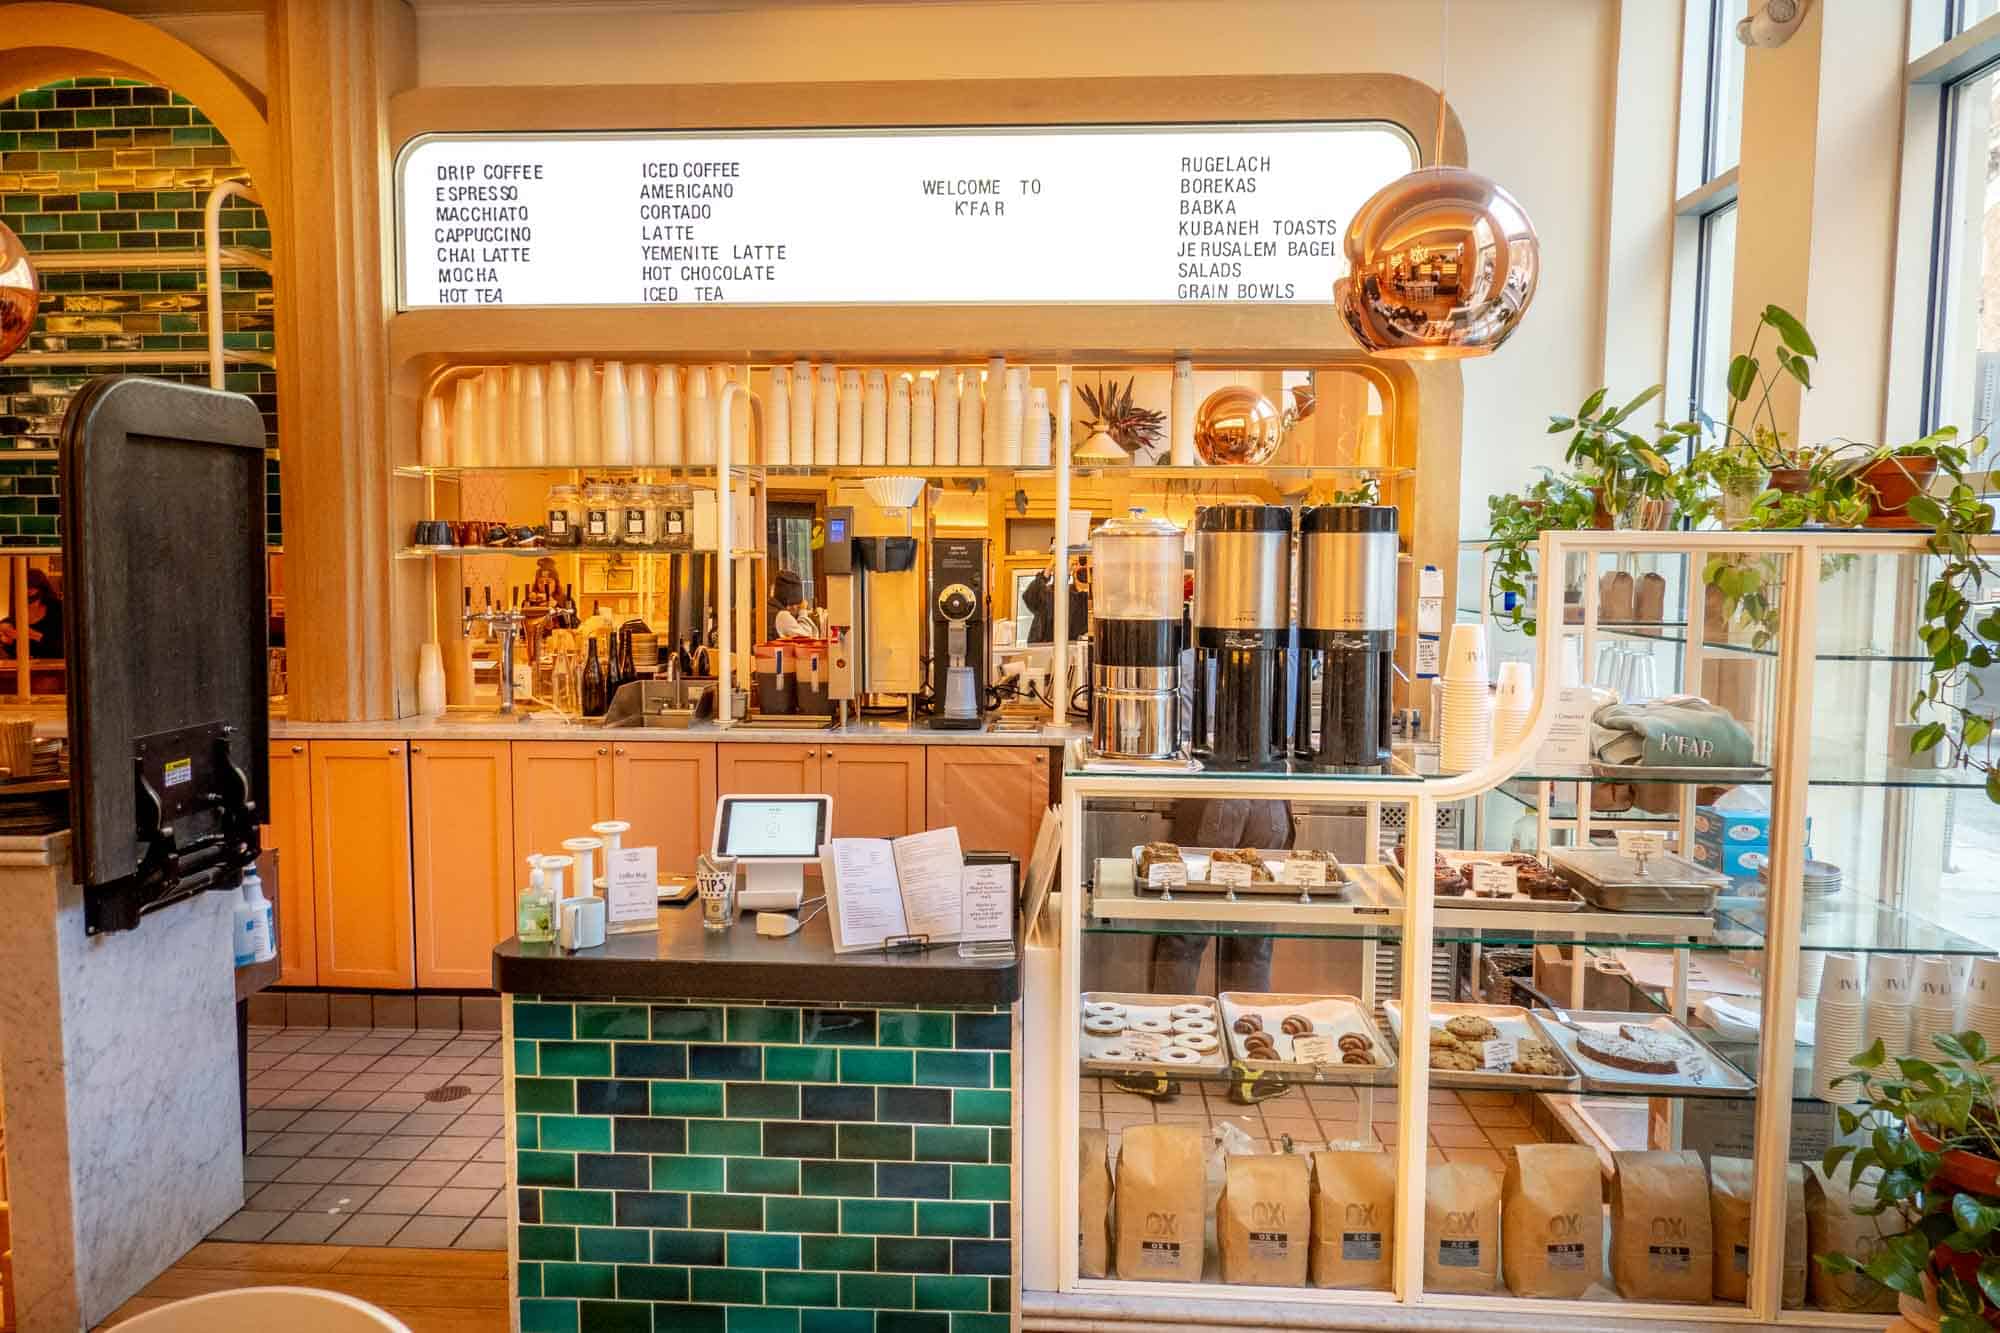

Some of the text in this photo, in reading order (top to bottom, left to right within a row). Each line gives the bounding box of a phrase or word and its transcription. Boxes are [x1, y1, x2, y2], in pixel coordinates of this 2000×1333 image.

[643, 162, 739, 178] ICED COFFEE
[1182, 156, 1270, 172] RUGELACH
[438, 165, 543, 180] DRIP COFFEE
[640, 183, 733, 199] AMERICANO
[923, 179, 1040, 195] WELCOME TO
[1181, 178, 1256, 193] BOREKAS
[436, 186, 518, 201] ESPRESSO
[436, 206, 528, 222] MACCHIATO
[641, 204, 710, 220] CORTADO
[1181, 200, 1236, 214] BABKA
[435, 227, 531, 243] CAPPUCCINO
[643, 226, 694, 240] LATTE
[1179, 220, 1336, 236] KUBANEH TOASTS
[437, 248, 530, 262] CHAI LATTE
[642, 245, 786, 260] YEMENITE LATTE
[1177, 242, 1276, 257] JERUSALEM
[439, 268, 498, 283] MOCHA
[643, 266, 774, 280] HOT CHOCOLATE
[1179, 263, 1241, 278] SALADS
[440, 288, 502, 303] HOT TEA
[644, 286, 723, 301] ICED TEA
[1178, 284, 1294, 299] GRAIN BOWLS
[699, 879, 726, 892] TIPS
